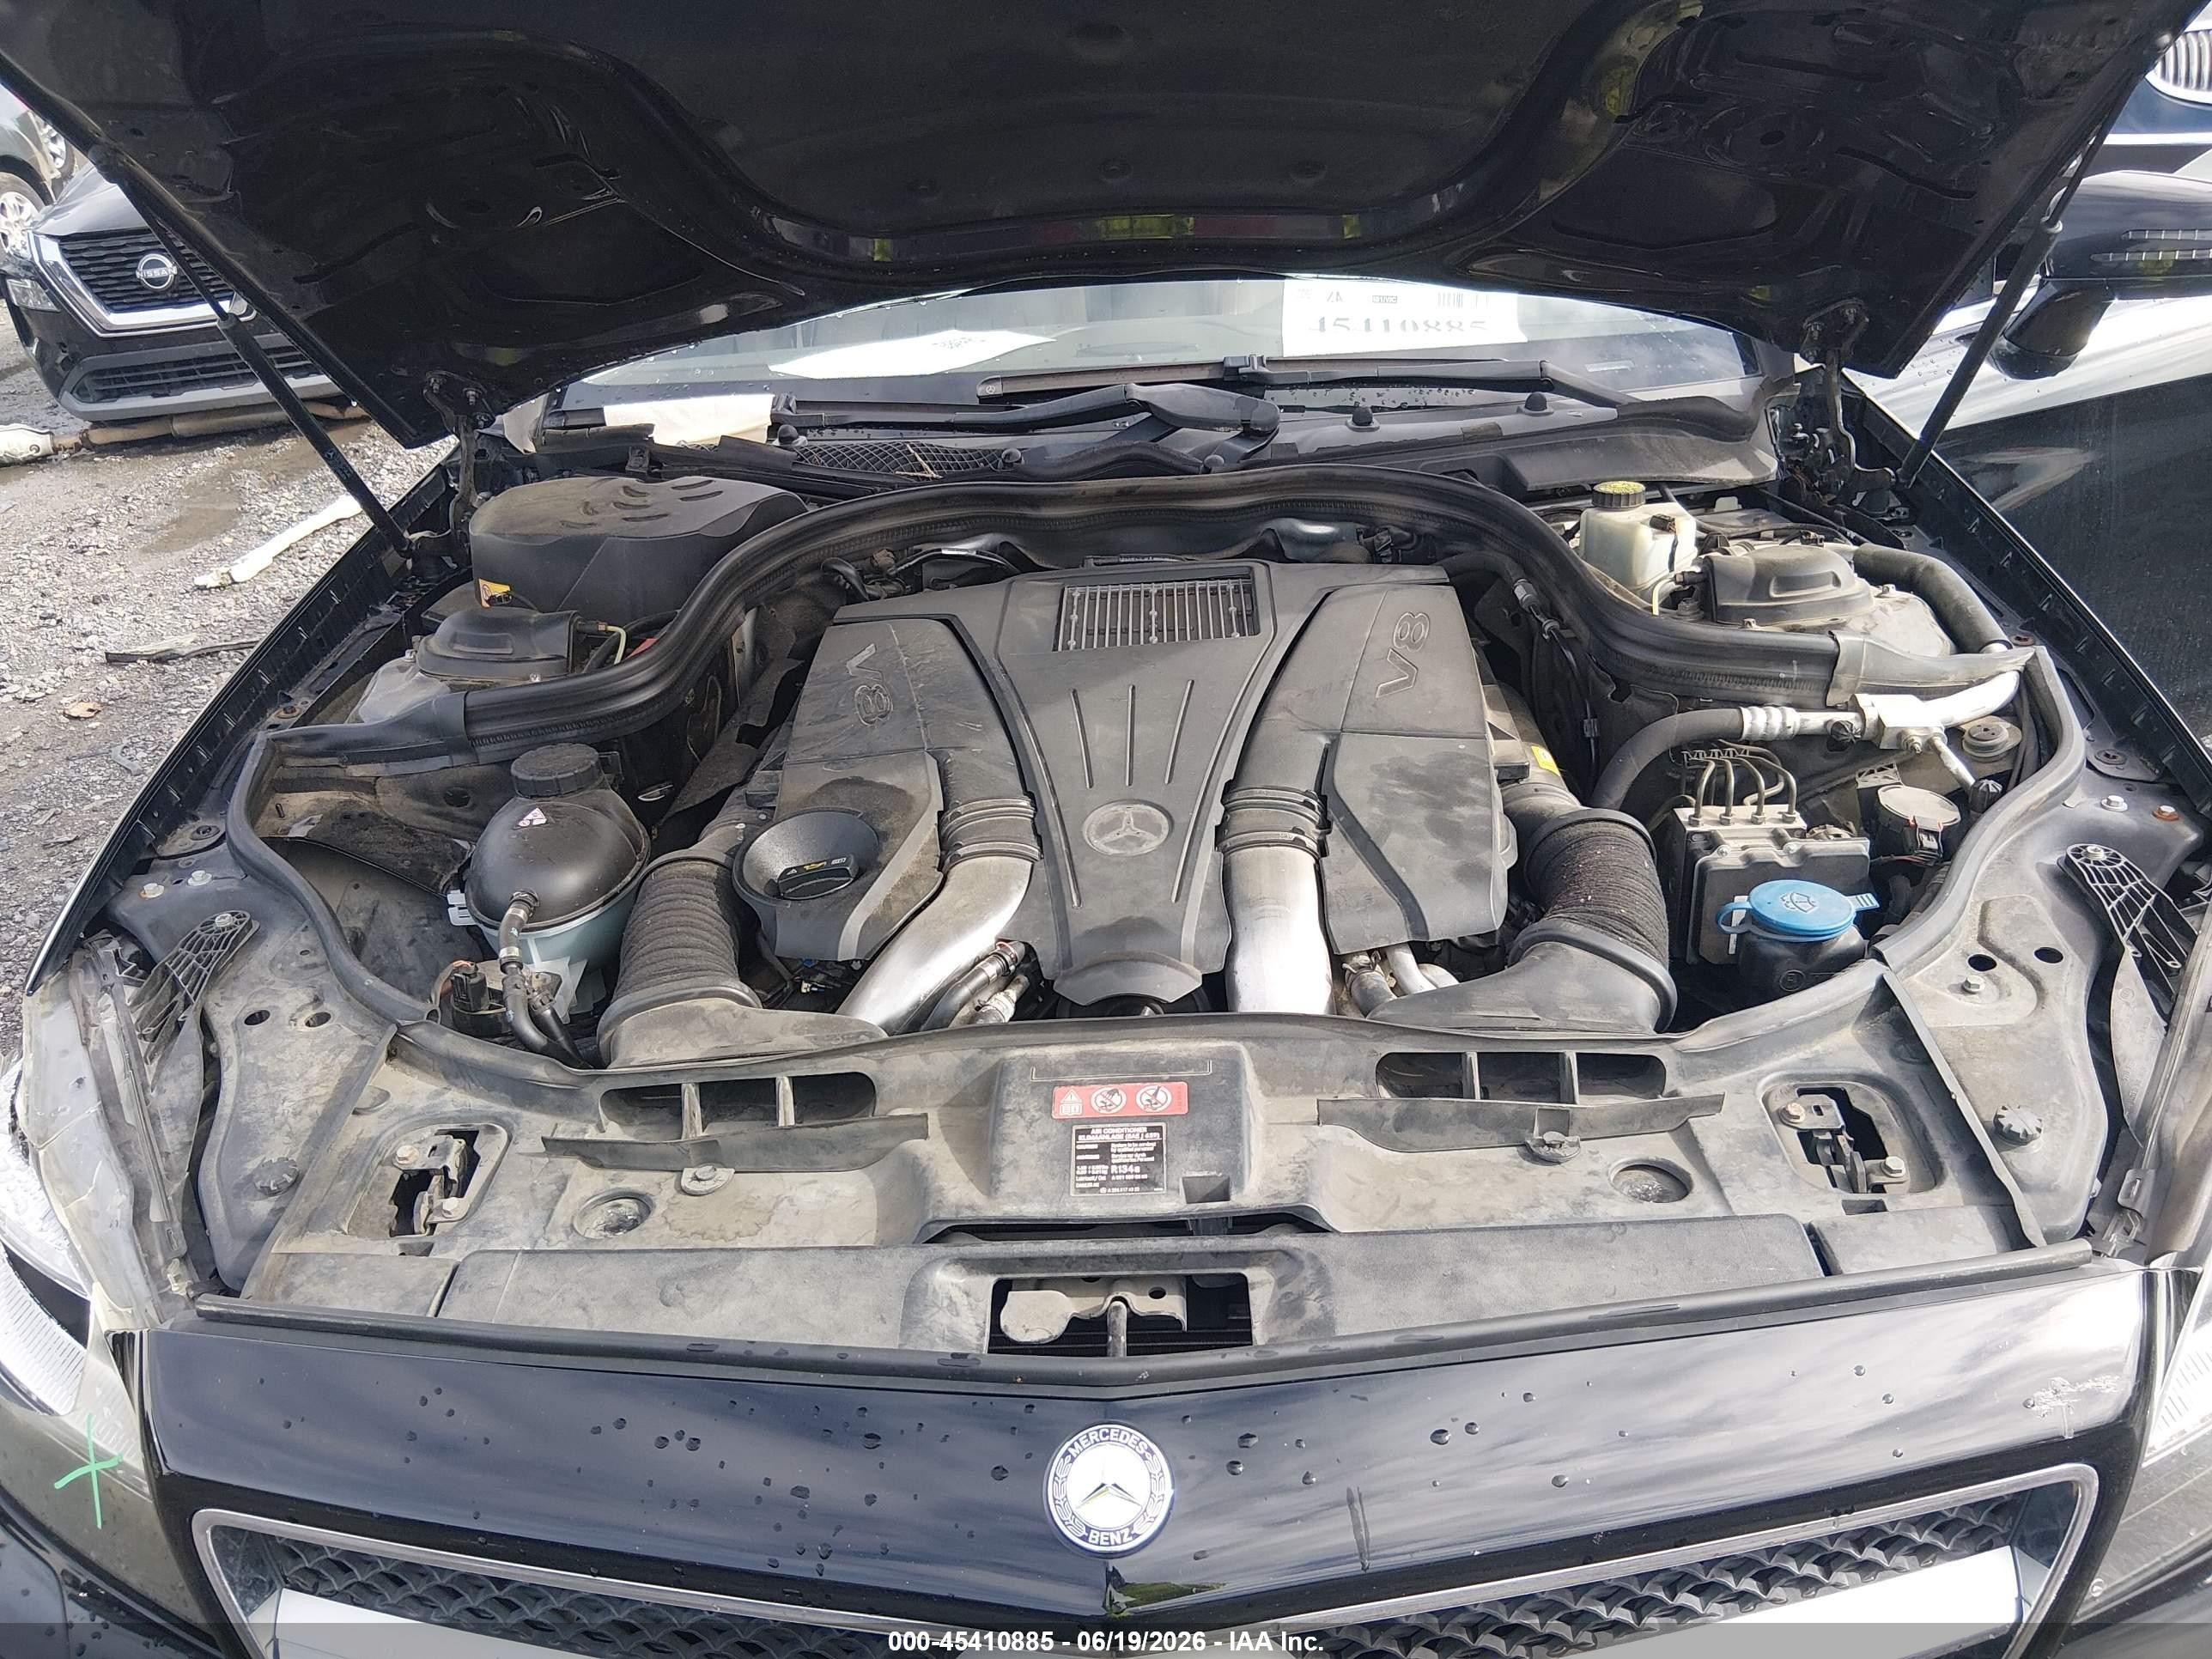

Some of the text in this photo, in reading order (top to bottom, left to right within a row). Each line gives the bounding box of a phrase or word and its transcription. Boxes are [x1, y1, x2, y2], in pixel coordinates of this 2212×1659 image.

[136, 265, 178, 279] NISSAN
[1375, 611, 1431, 699] V8
[846, 643, 894, 727] V8
[1110, 1164, 1140, 1174] R134a
[1068, 1428, 1148, 1457] MERCEDES
[1089, 1528, 1133, 1545] BENZ
